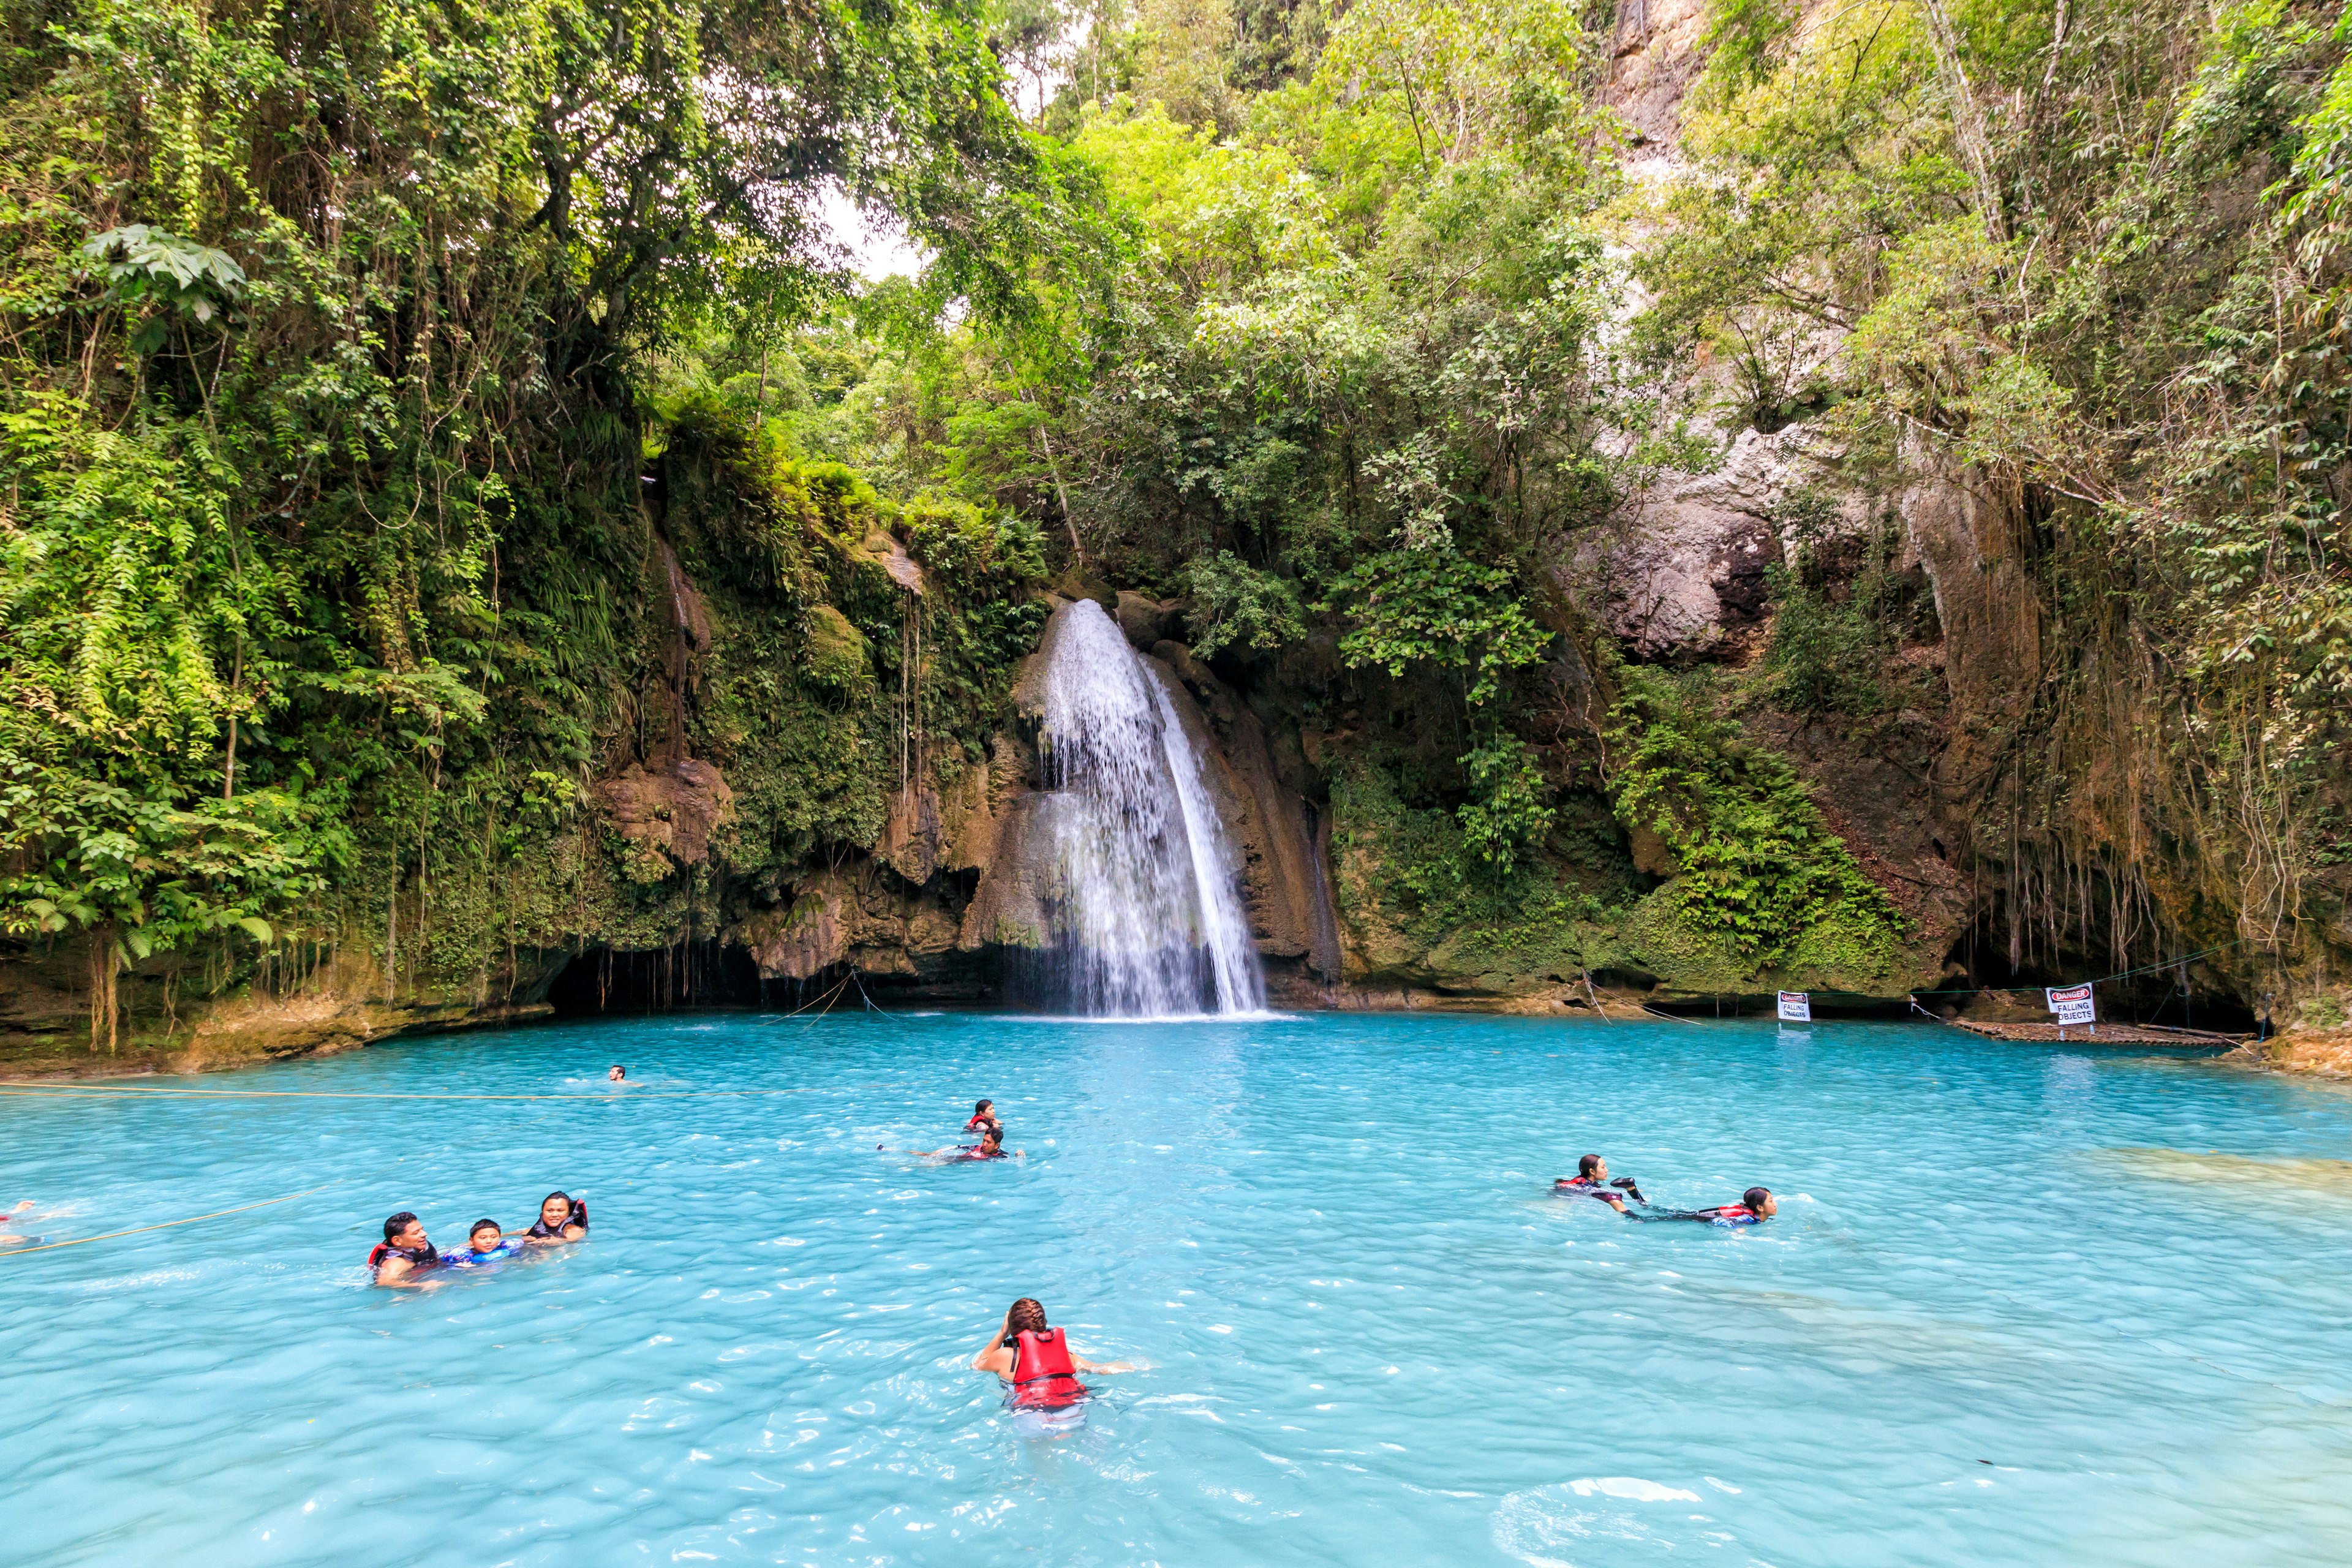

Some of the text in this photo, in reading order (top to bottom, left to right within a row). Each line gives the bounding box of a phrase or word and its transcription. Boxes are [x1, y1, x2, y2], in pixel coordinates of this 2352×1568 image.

[2056, 990, 2085, 1000] DANGER
[2058, 1003, 2089, 1012] FALLING
[2059, 1011, 2091, 1020] OBJECTS
